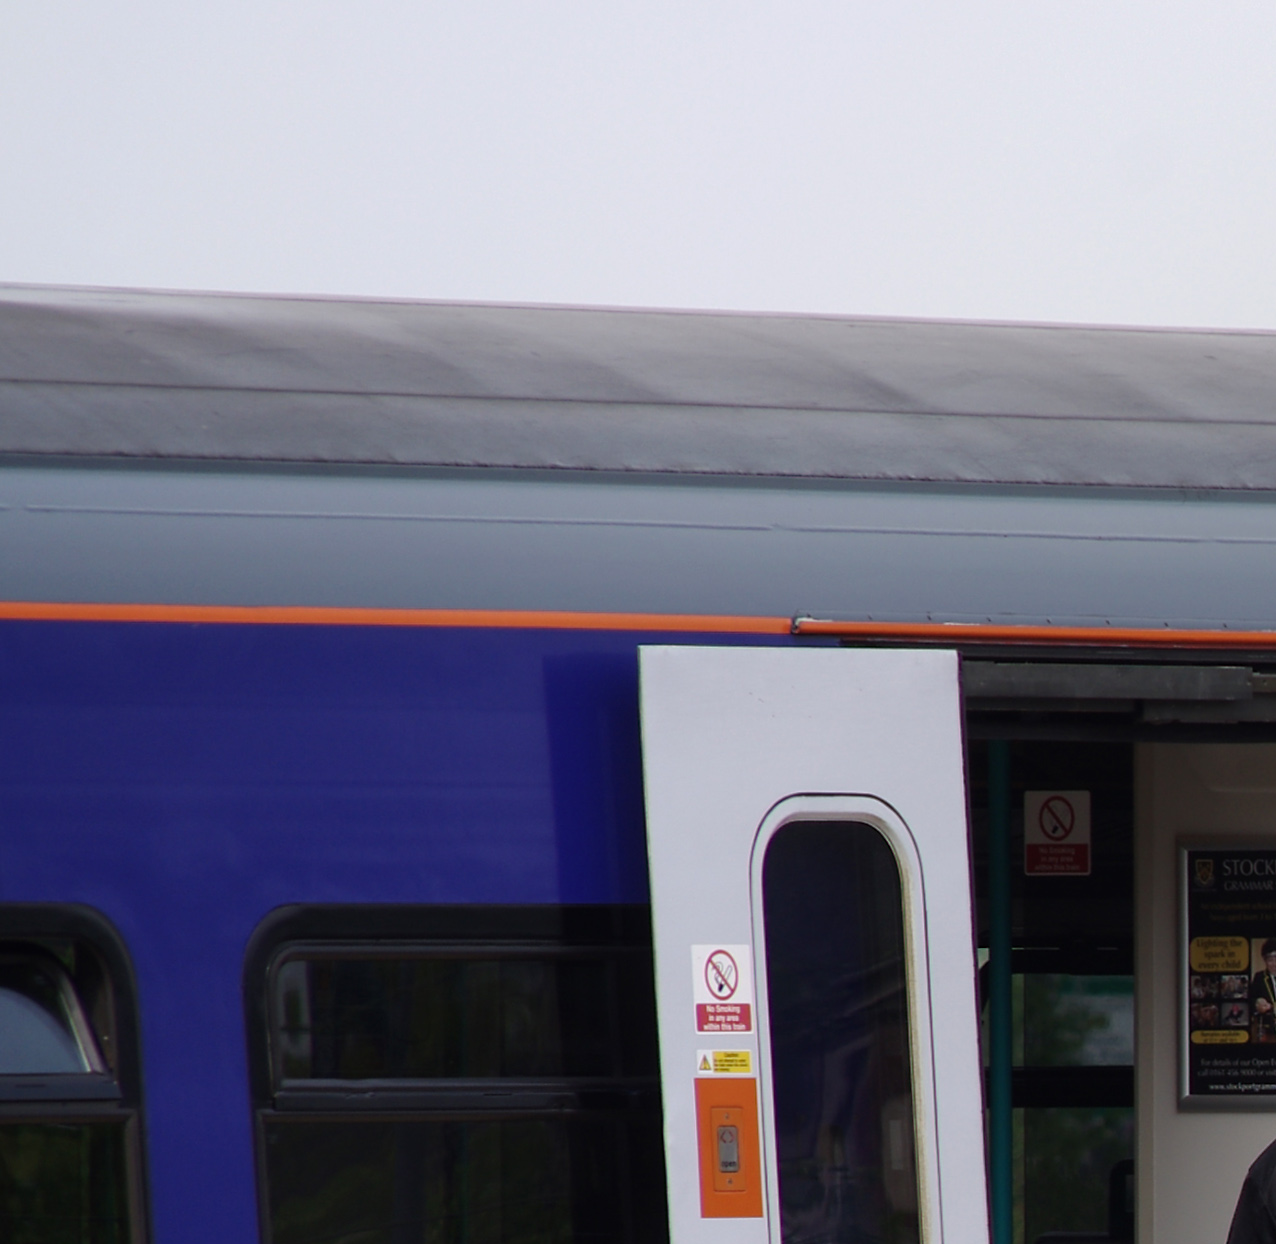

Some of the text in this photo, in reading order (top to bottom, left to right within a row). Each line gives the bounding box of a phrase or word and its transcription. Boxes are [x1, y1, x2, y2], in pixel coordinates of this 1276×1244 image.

[1048, 847, 1075, 855] Smoking
[1224, 880, 1274, 891] GRAMMAR
[1196, 939, 1242, 950] Lighting the
[1204, 949, 1236, 960] spark in
[1198, 960, 1241, 971] every child
[705, 1004, 741, 1014] No Smoking
[1200, 1058, 1211, 1066] For
[1211, 1057, 1232, 1066] details
[1232, 1058, 1240, 1066] of
[1252, 1058, 1270, 1068] Open
[1198, 1068, 1209, 1076] call
